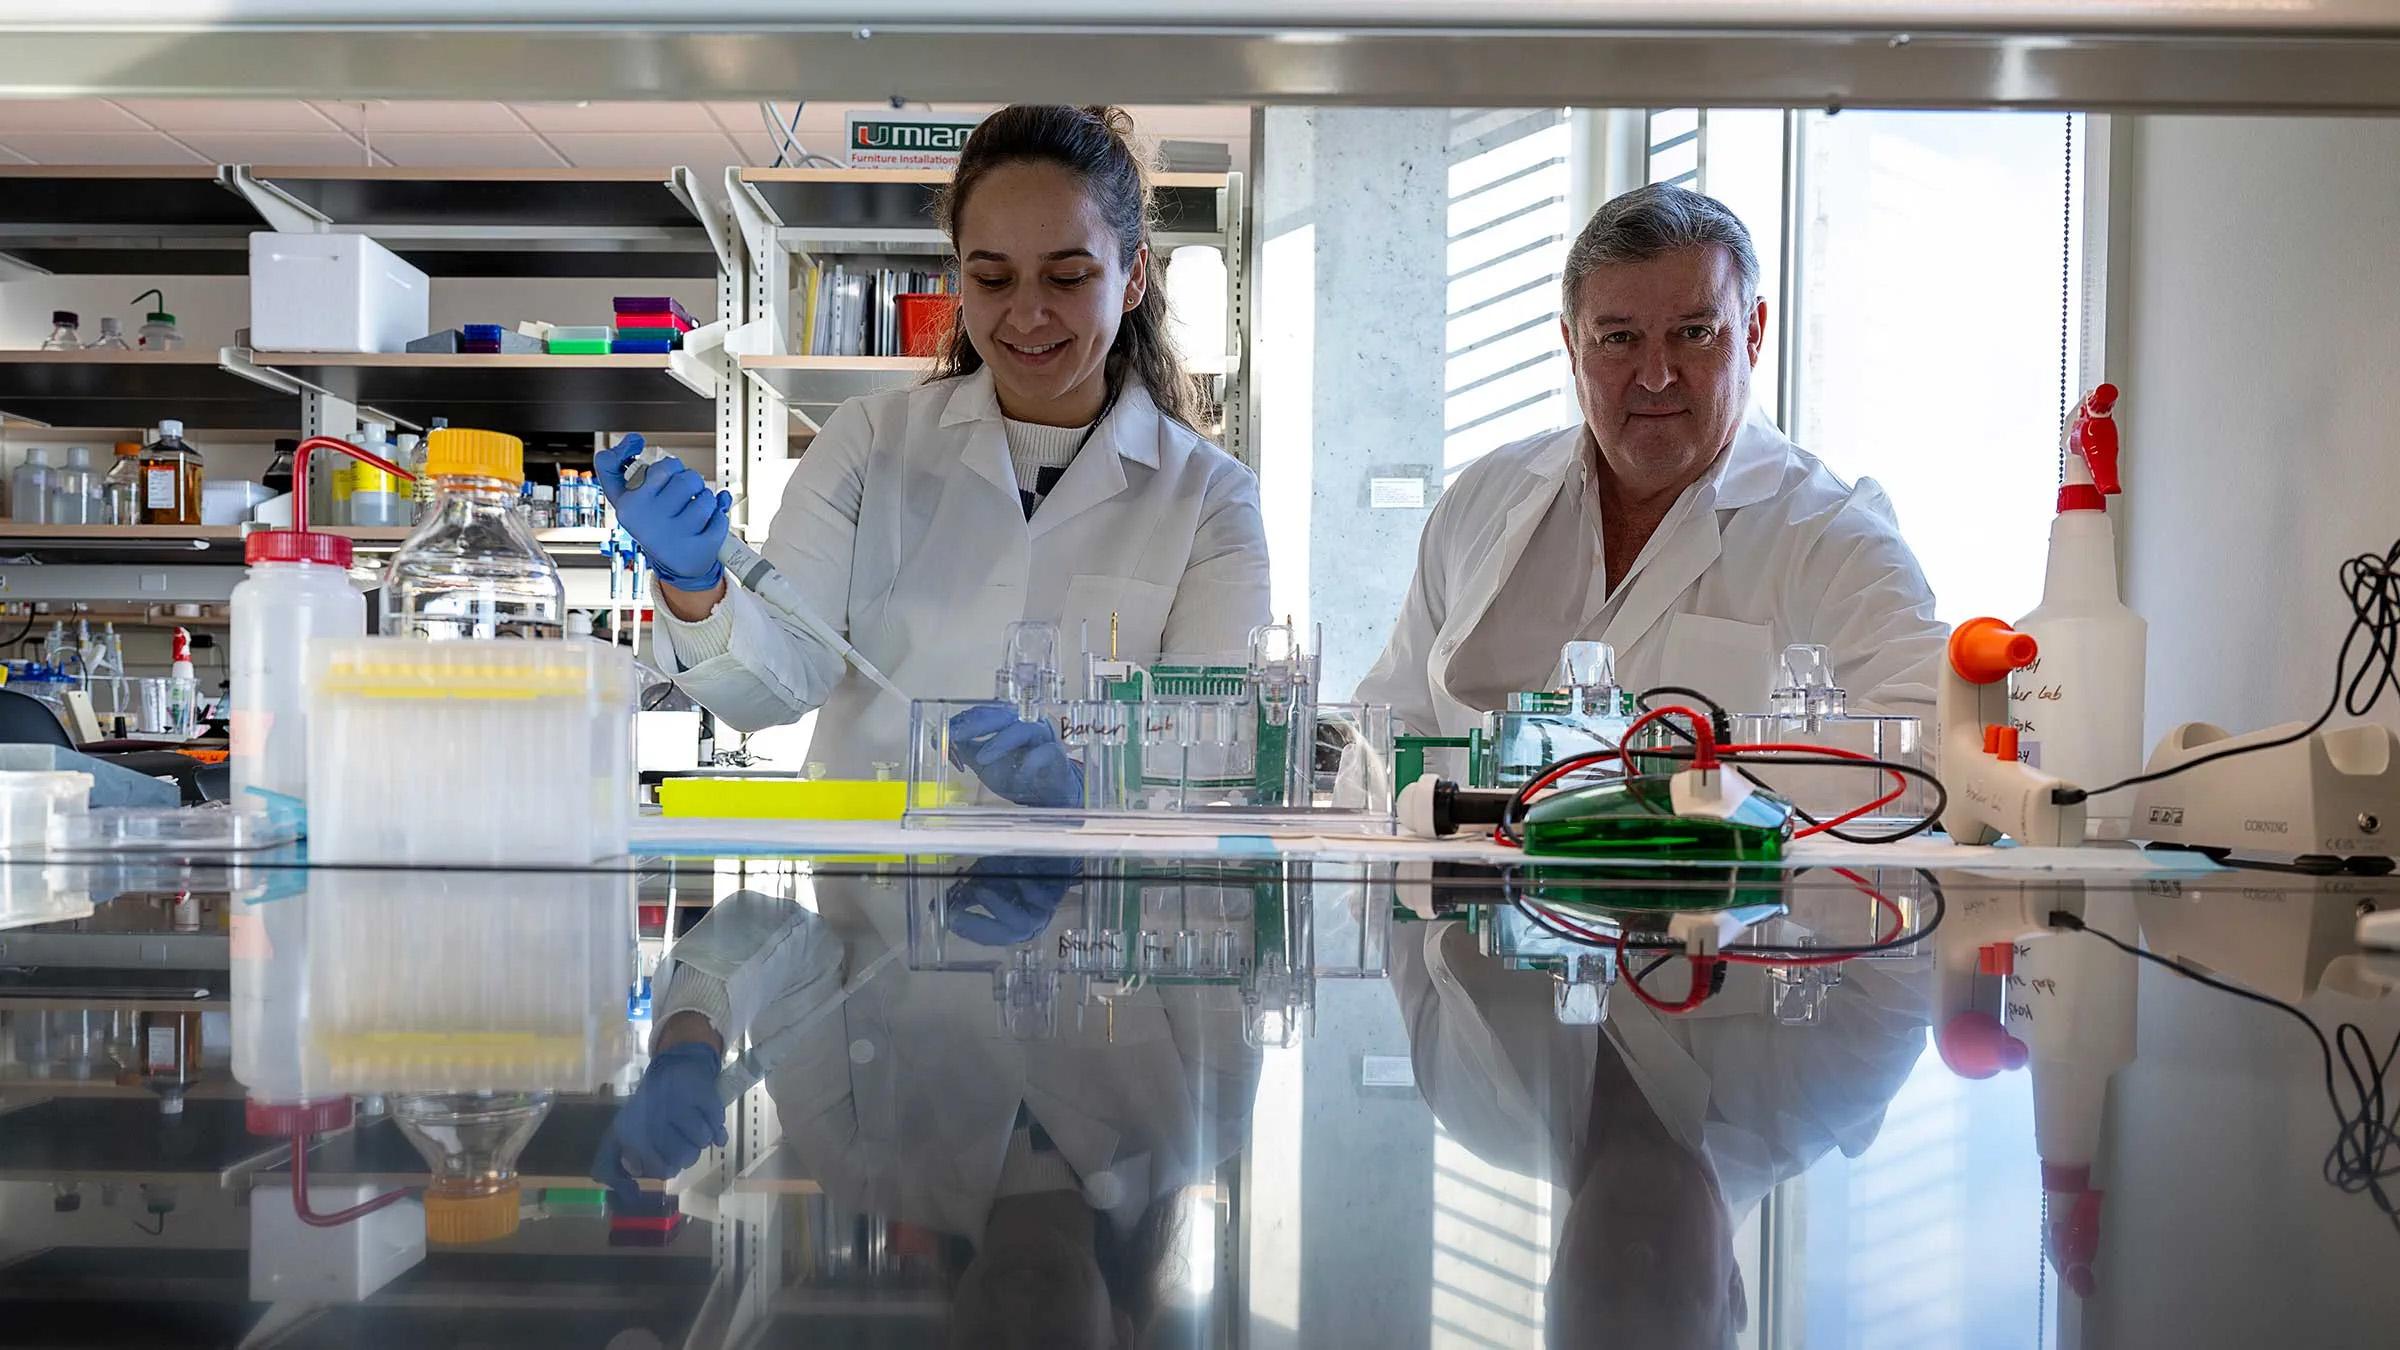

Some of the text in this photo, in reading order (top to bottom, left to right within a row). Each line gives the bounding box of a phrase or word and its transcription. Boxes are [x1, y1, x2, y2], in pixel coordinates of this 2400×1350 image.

[851, 153, 897, 164] Furniture
[2038, 685, 2063, 701] Lab
[2244, 819, 2289, 834] CORNING
